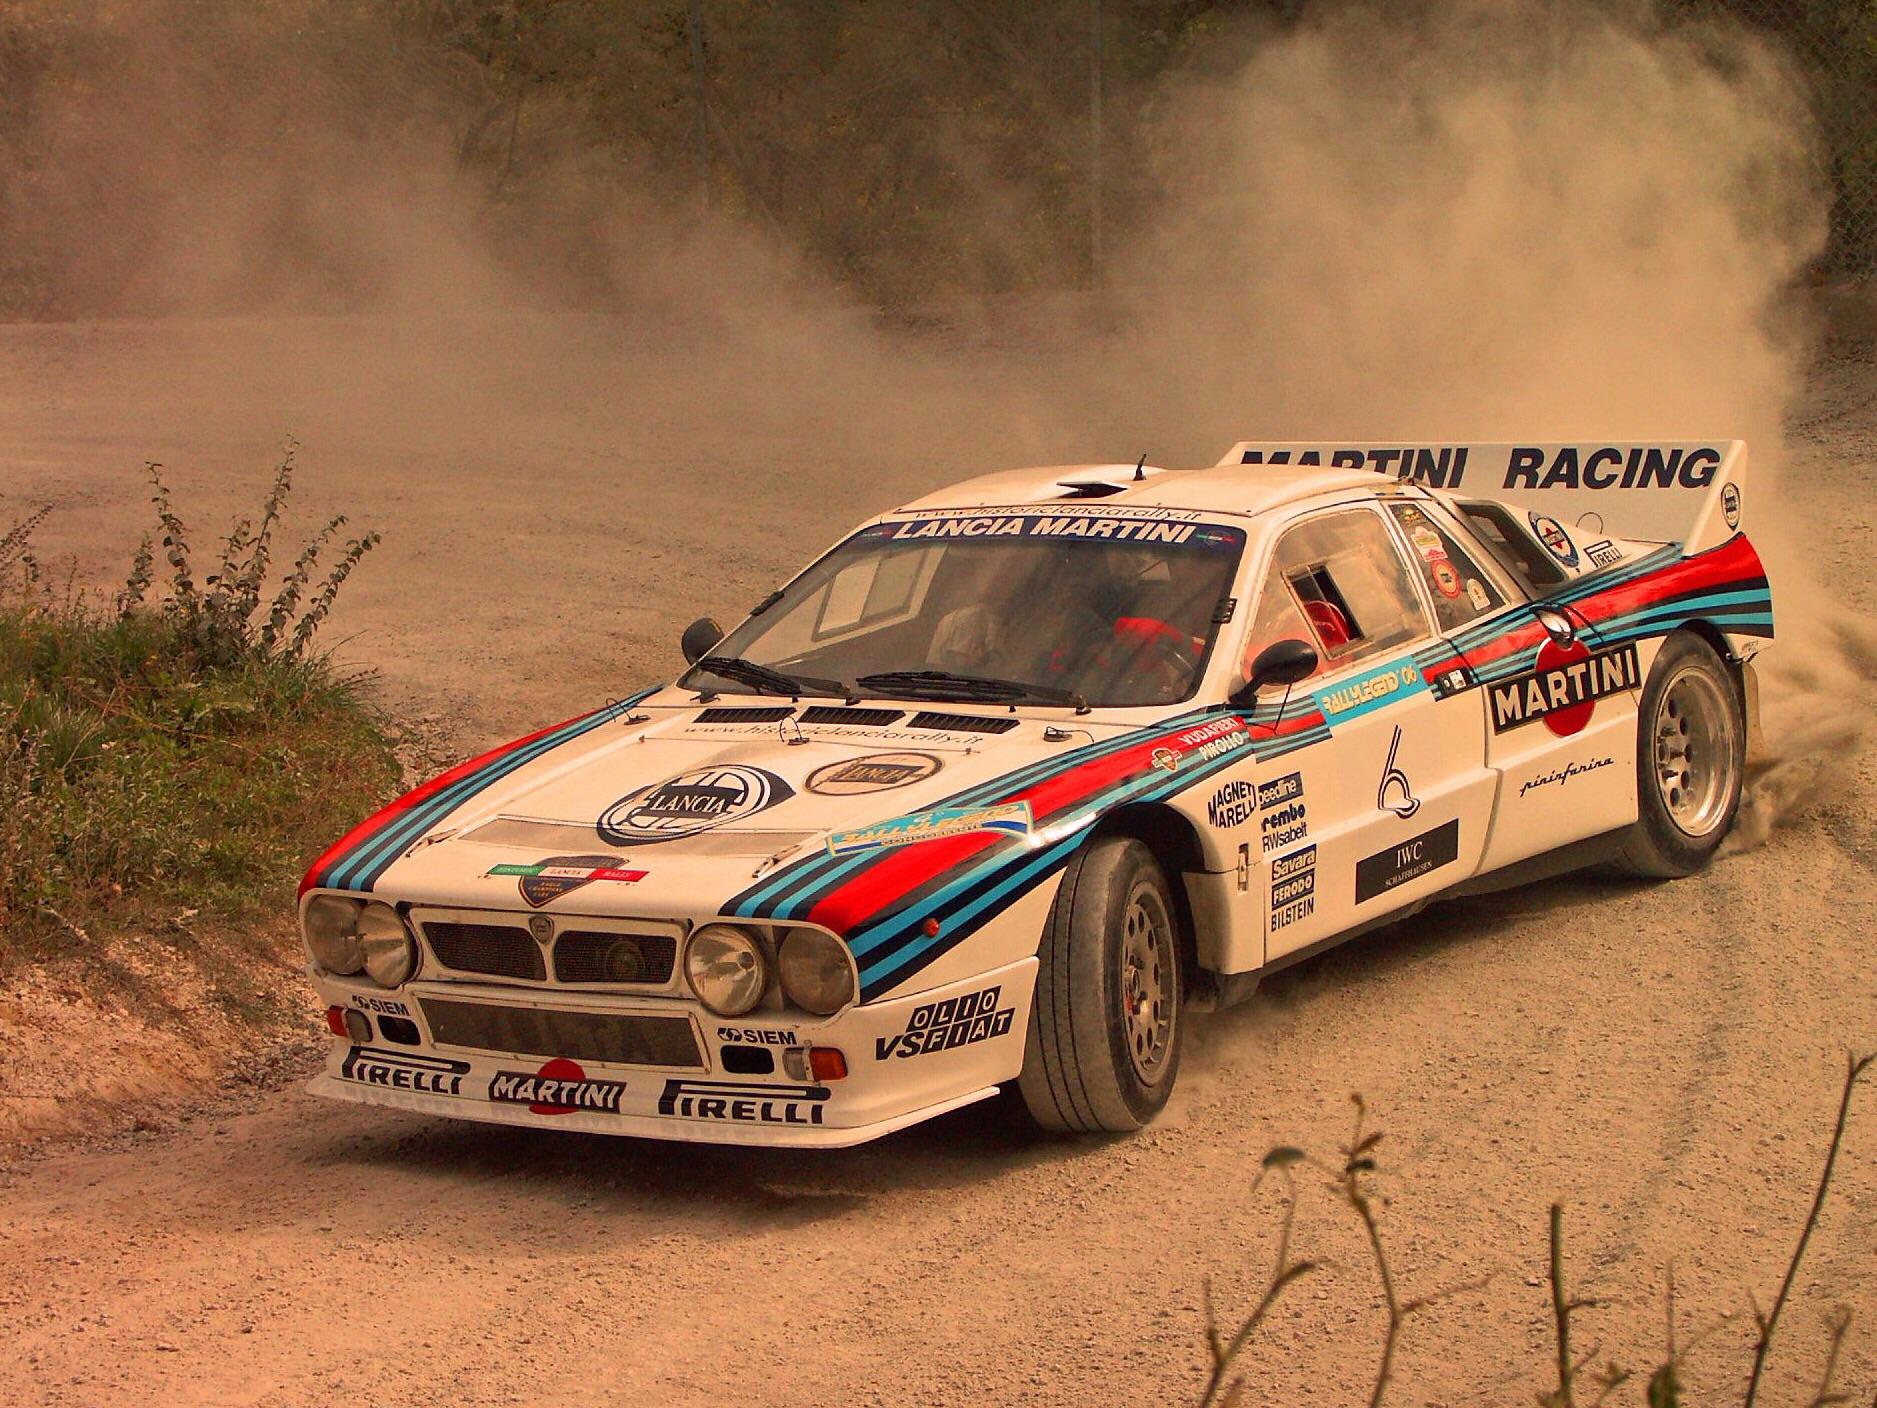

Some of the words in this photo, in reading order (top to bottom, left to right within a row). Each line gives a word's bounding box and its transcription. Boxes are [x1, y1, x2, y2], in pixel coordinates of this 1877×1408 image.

[1502, 448, 1721, 490] RACING
[892, 518, 1020, 539] LANCIA
[1027, 518, 1197, 543] MARTINI
[1493, 649, 1636, 727] MARTINI
[1377, 724, 1421, 820] 6
[1518, 756, 1616, 798] pininfarina
[650, 793, 726, 815] LANCIA
[1207, 781, 1257, 816] MAGNETI
[1208, 797, 1257, 829] MARELLI
[1273, 849, 1316, 879] Savara
[1395, 840, 1424, 869] IWC
[1273, 875, 1313, 905] FERODO
[1271, 896, 1315, 933] BILSTEIN
[370, 998, 410, 1017] SIEM
[910, 988, 998, 1031] OLIO
[743, 1028, 797, 1046] SIEM
[341, 1045, 471, 1095] PIRELLI
[492, 1075, 621, 1109] MARTINI
[657, 1078, 832, 1125] PIRELLI
